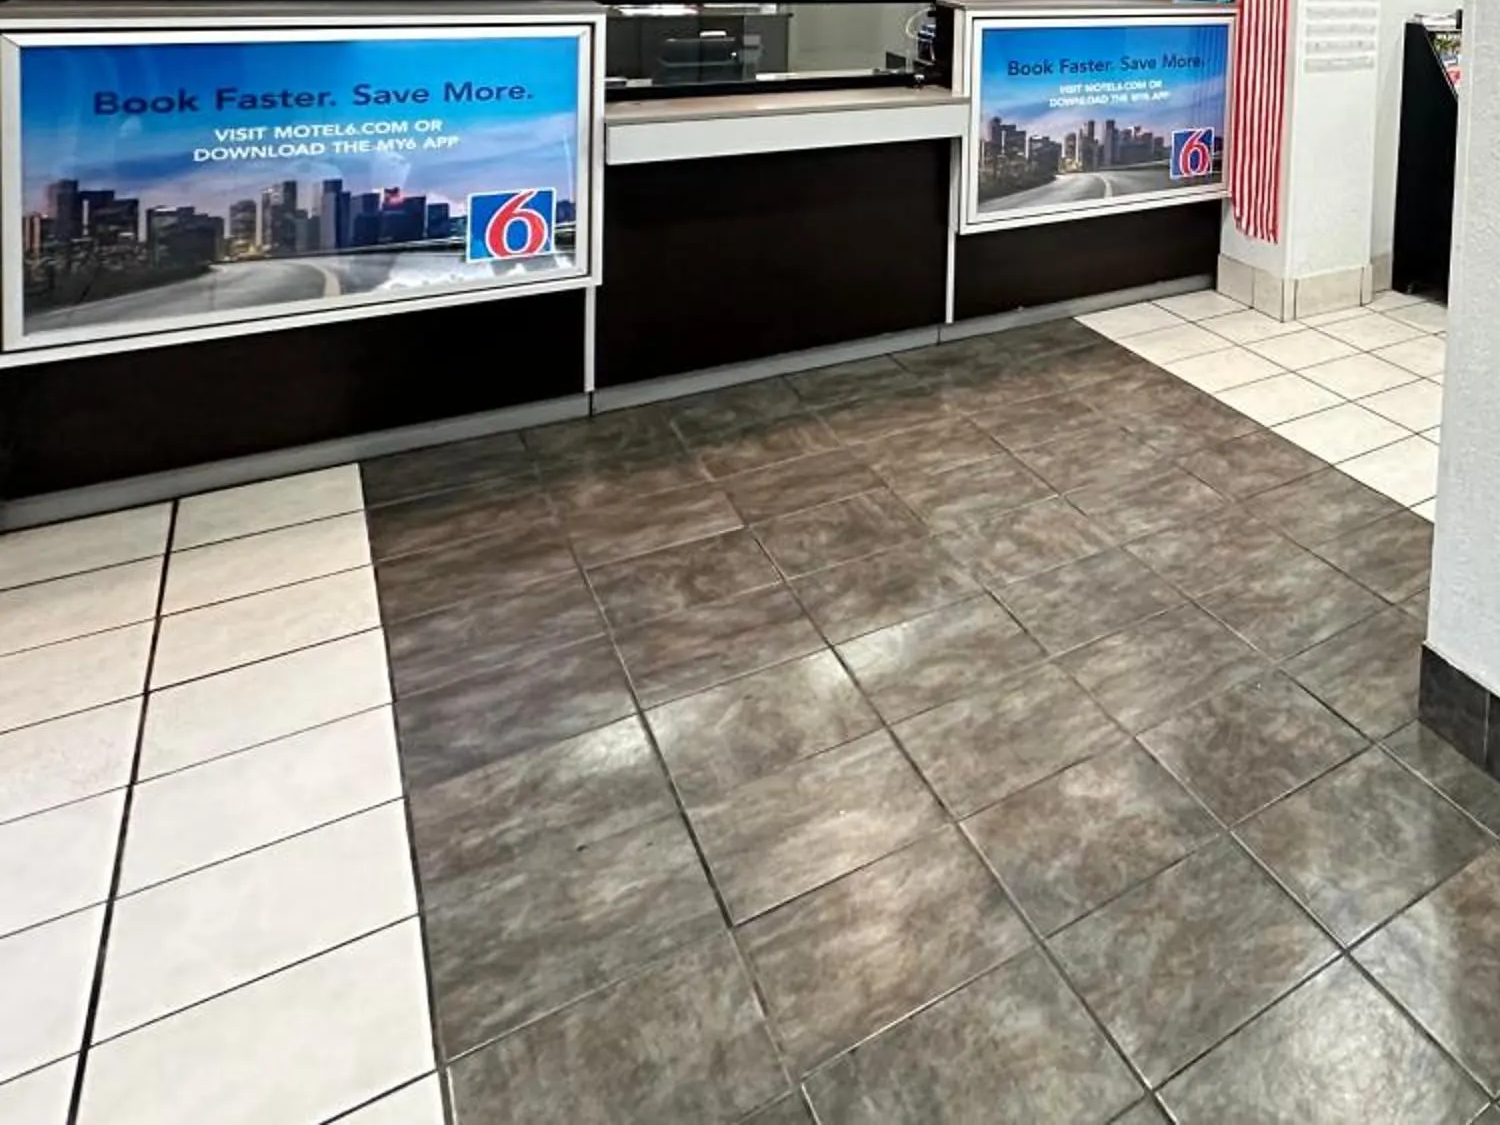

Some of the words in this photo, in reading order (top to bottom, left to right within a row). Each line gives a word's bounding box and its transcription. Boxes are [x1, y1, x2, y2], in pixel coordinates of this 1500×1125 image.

[1008, 59, 1053, 76] Book
[1060, 57, 1114, 74] Faster.
[1120, 55, 1157, 71] Save
[1163, 53, 1205, 69] More.
[94, 88, 199, 115] Book
[215, 86, 337, 111] Faster.
[353, 83, 429, 106] Save
[443, 81, 533, 102] More.
[1050, 95, 1109, 108] DOWNLOAD
[1110, 94, 1129, 104] THE
[214, 126, 268, 142] VISIT
[274, 120, 407, 139] MOTEL6.COM
[414, 119, 443, 132] OR
[193, 142, 325, 162] DOWNLOAD
[333, 139, 371, 154] THE
[377, 137, 416, 152] MY6
[423, 135, 461, 150] APP
[1179, 128, 1212, 177] 6
[485, 188, 548, 260] 6
